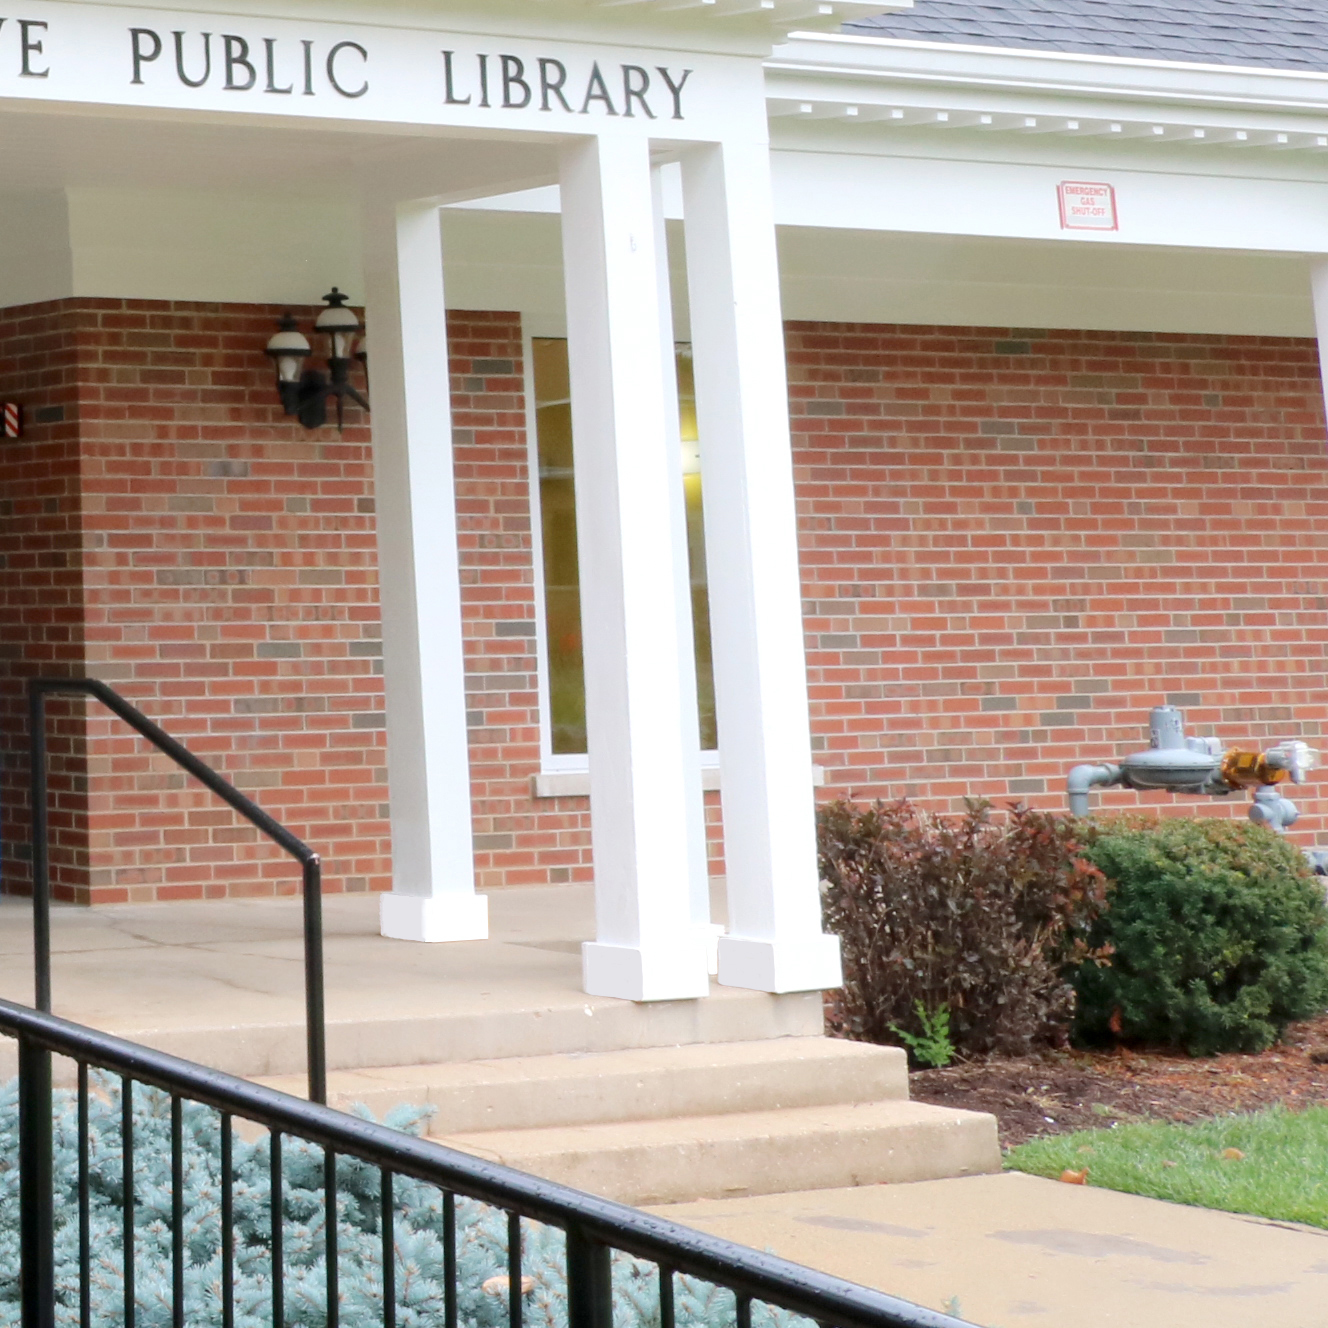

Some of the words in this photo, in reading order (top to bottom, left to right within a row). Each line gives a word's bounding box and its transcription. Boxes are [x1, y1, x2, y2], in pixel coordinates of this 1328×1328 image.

[128, 26, 369, 99] PUBLIC
[441, 49, 694, 120] LIBRARY
[1065, 186, 1108, 196] EMERGENCY
[1080, 197, 1096, 206] GAS
[1071, 206, 1106, 216] SHUT-OFF
